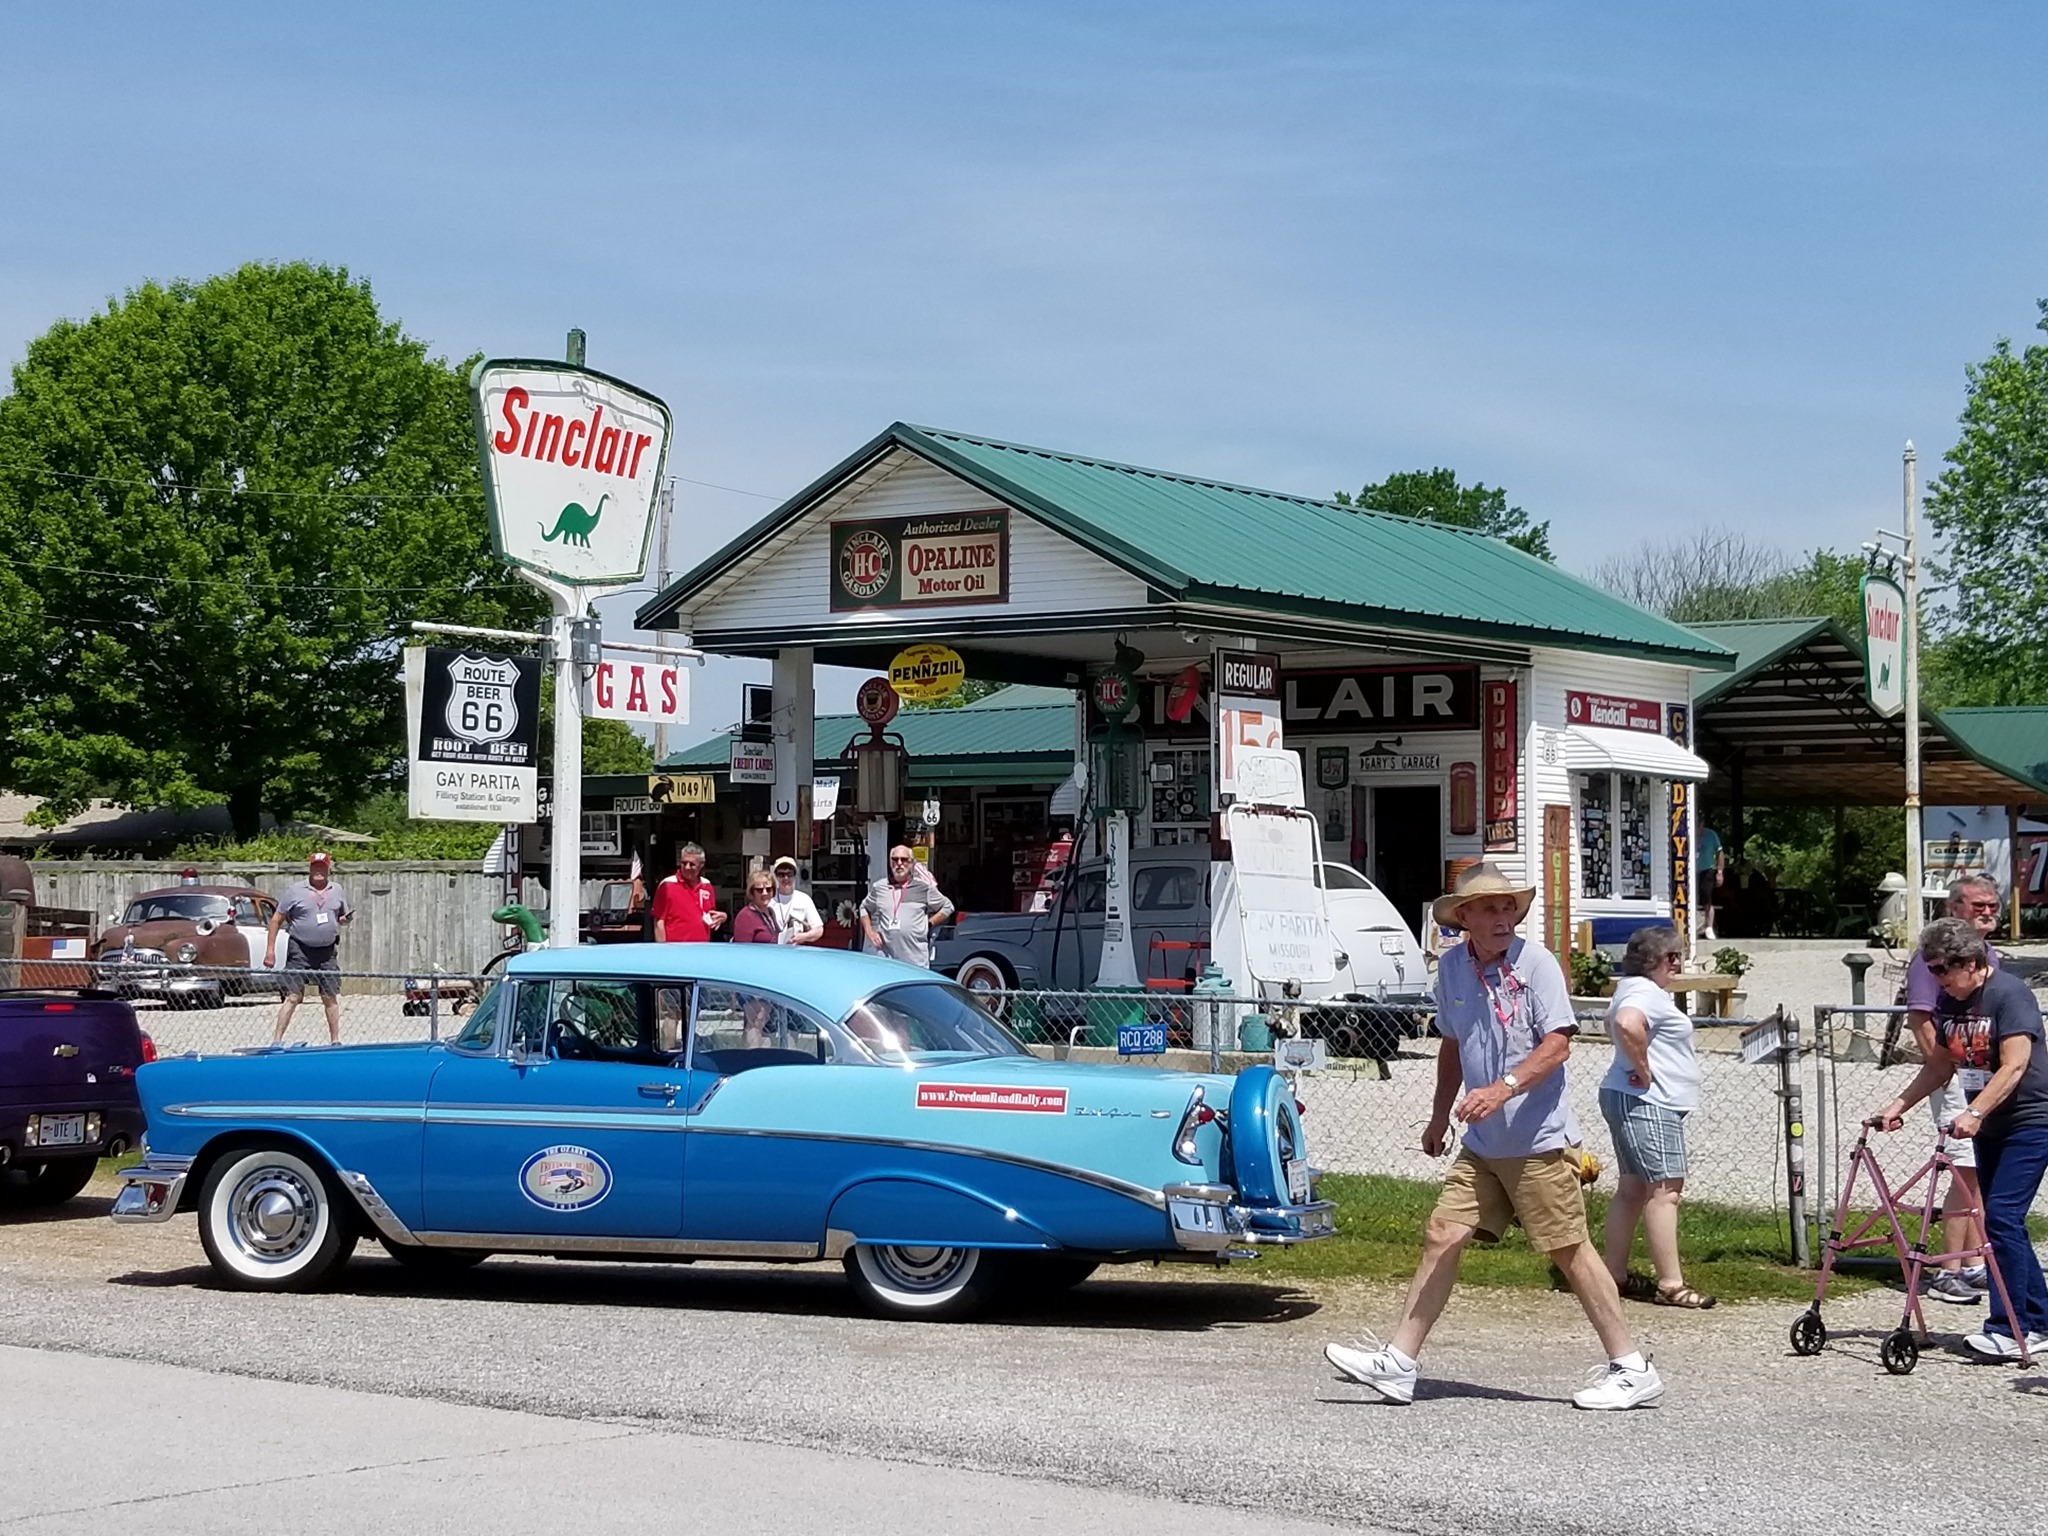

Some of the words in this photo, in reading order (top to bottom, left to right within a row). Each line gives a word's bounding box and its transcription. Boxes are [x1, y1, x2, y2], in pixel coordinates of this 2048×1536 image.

[495, 386, 652, 479] Sinclair
[902, 520, 961, 536] Authorized
[963, 516, 1001, 531] Dealer
[843, 532, 889, 559] SINCLAIR
[908, 543, 995, 576] OPALINE
[843, 567, 890, 596] GASOLINE
[918, 577, 961, 594] Motor
[964, 574, 985, 592] Oil
[1867, 592, 1900, 643] Sinclair
[463, 667, 506, 682] ROUTE
[893, 660, 962, 682] PENNZOIL
[1225, 662, 1272, 689] REGULAR
[467, 686, 501, 700] BEER
[597, 663, 677, 714] GAS
[462, 701, 503, 732] 66
[1590, 704, 1627, 726] Kendall
[433, 737, 473, 752] ROOT
[490, 741, 528, 756] BEER
[1492, 687, 1508, 815] DUNLOP
[1365, 756, 1396, 769] GARY'S
[1401, 756, 1435, 769] GARAGE
[436, 771, 465, 787] GAY
[471, 773, 521, 790] PARITA
[677, 784, 699, 796] 1049
[436, 791, 459, 802] Filling
[460, 792, 485, 801] Station
[488, 793, 494, 801] &
[496, 794, 521, 805] Garage
[615, 799, 646, 812] ROUTE
[926, 812, 938, 823] 66
[1486, 820, 1515, 842] TIRES
[1120, 1031, 1140, 1047] RCQ
[1143, 1030, 1163, 1046] 288
[920, 1089, 1063, 1107] www.FreedomRoadRally.com
[53, 1122, 69, 1137] UTE
[73, 1121, 79, 1137] 1
